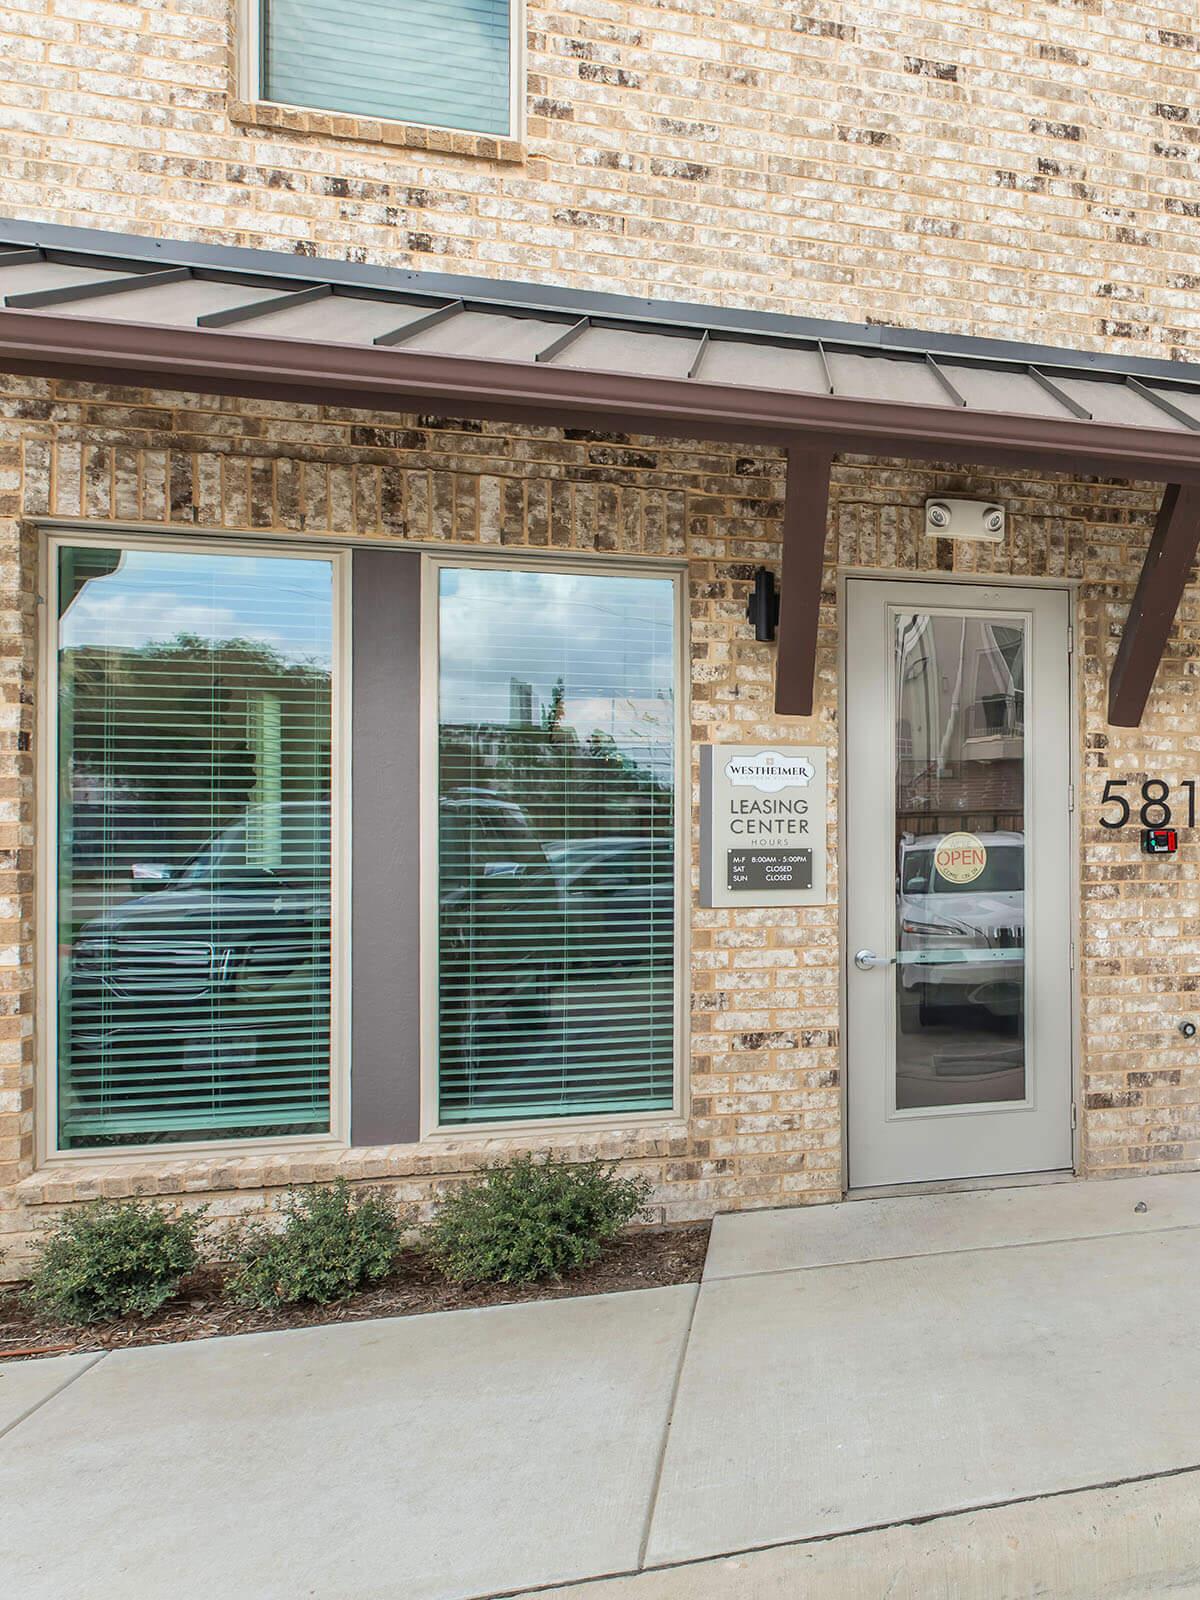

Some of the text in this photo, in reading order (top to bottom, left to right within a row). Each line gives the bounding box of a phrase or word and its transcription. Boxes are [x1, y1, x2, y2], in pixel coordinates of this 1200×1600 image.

[730, 765, 809, 777] WESTHEIMER
[730, 799, 809, 814] LEASING
[730, 819, 809, 834] CENTER
[751, 838, 789, 847] HOURS
[782, 855, 807, 863] 5:00PM
[936, 849, 985, 866] OPEN
[732, 865, 793, 873] SAT CLOSED
[732, 874, 748, 882] SUN
